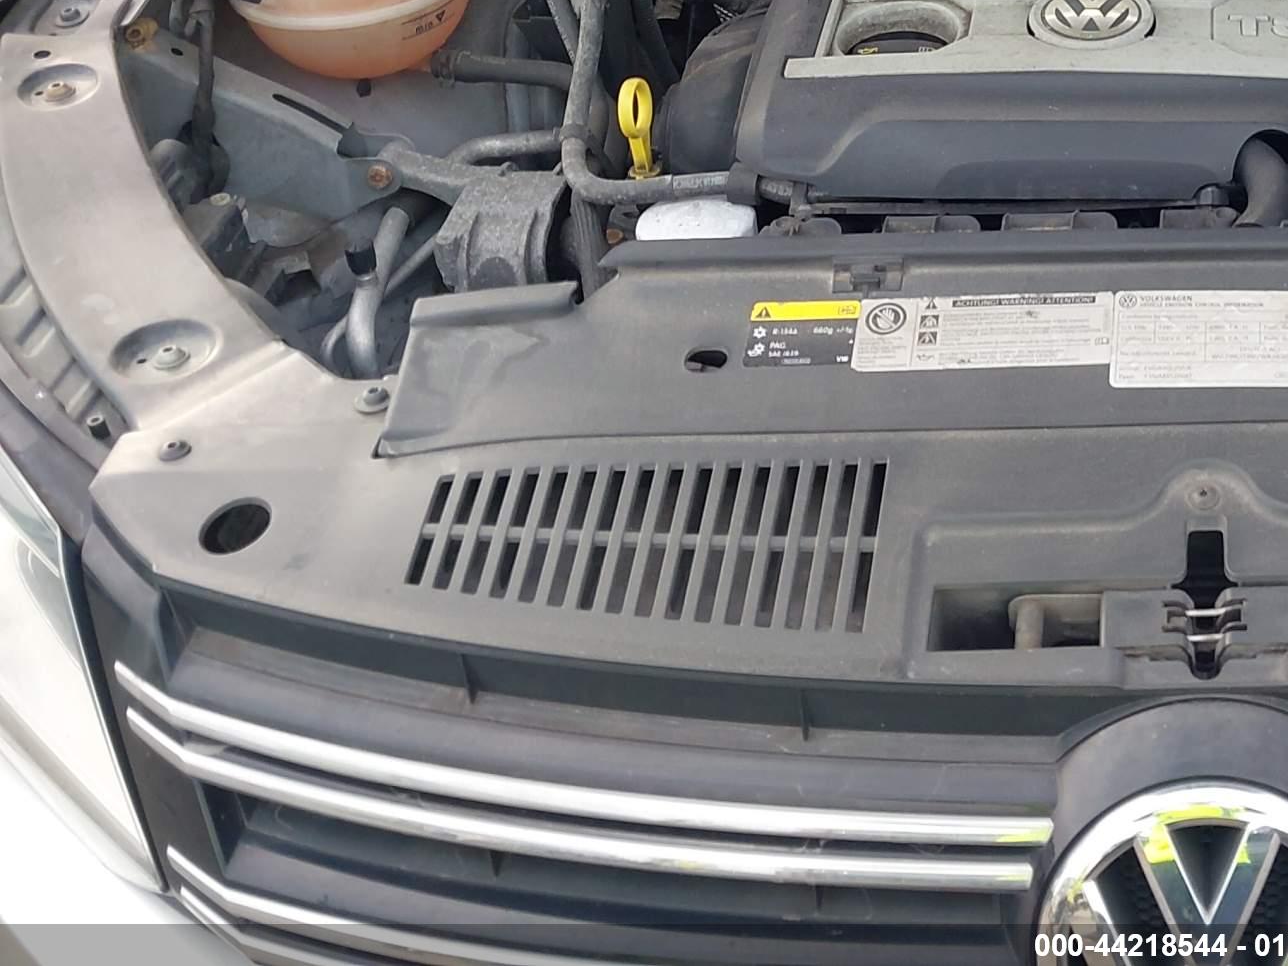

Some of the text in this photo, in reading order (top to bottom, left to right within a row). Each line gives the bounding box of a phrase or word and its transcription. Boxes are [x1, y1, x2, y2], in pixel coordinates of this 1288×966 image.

[415, 20, 434, 35] min
[955, 296, 1094, 307] ACHTUNG! WARNING! ATTENTION!
